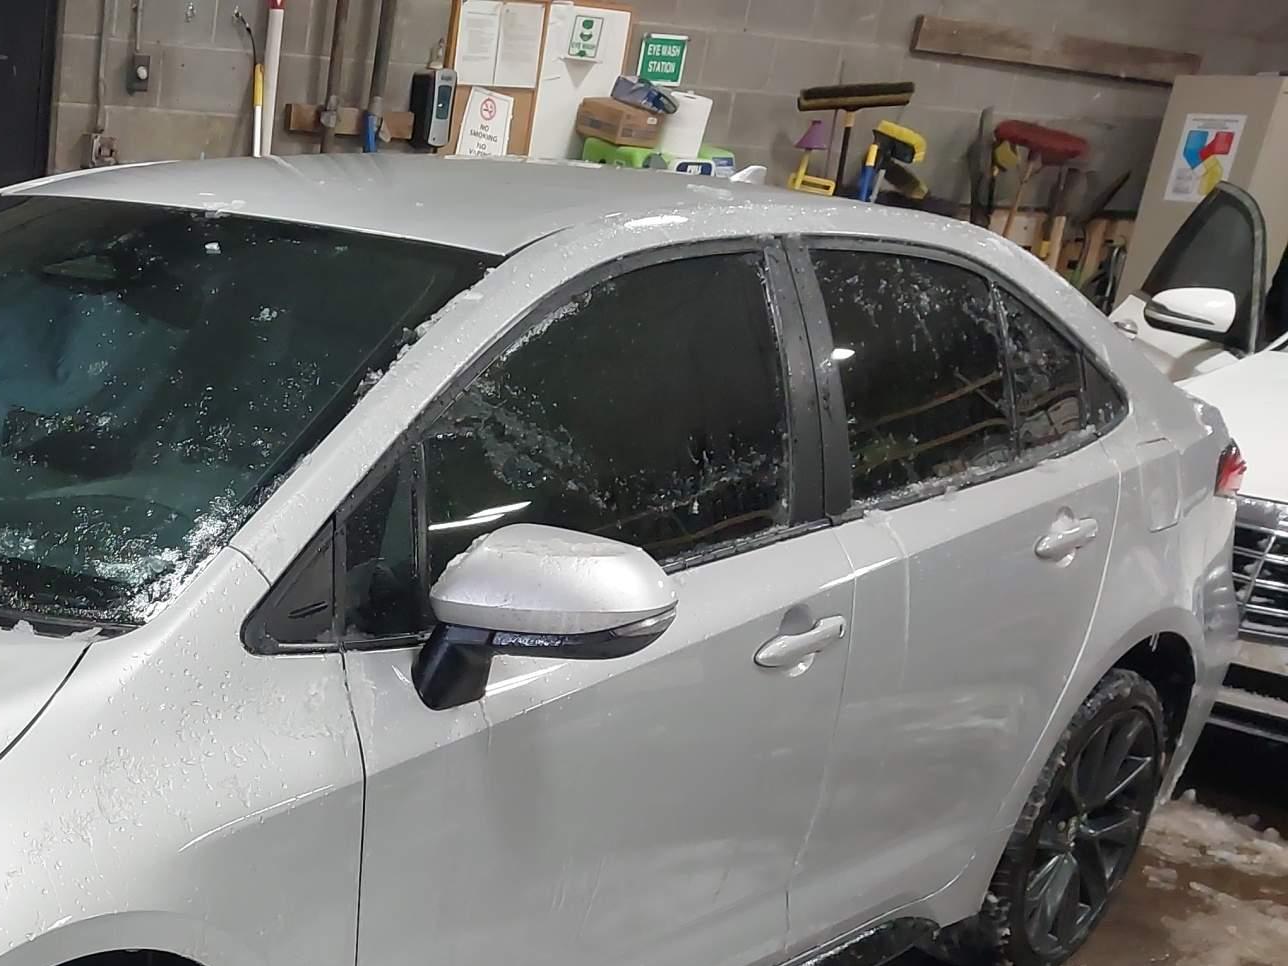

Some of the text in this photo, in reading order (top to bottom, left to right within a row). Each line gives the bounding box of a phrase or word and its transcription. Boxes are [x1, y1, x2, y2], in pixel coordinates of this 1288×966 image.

[647, 43, 681, 57] EYE WASH
[647, 60, 676, 73] STATION
[479, 124, 490, 132] NO
[469, 129, 498, 143] SMOKING
[476, 142, 487, 150] NO
